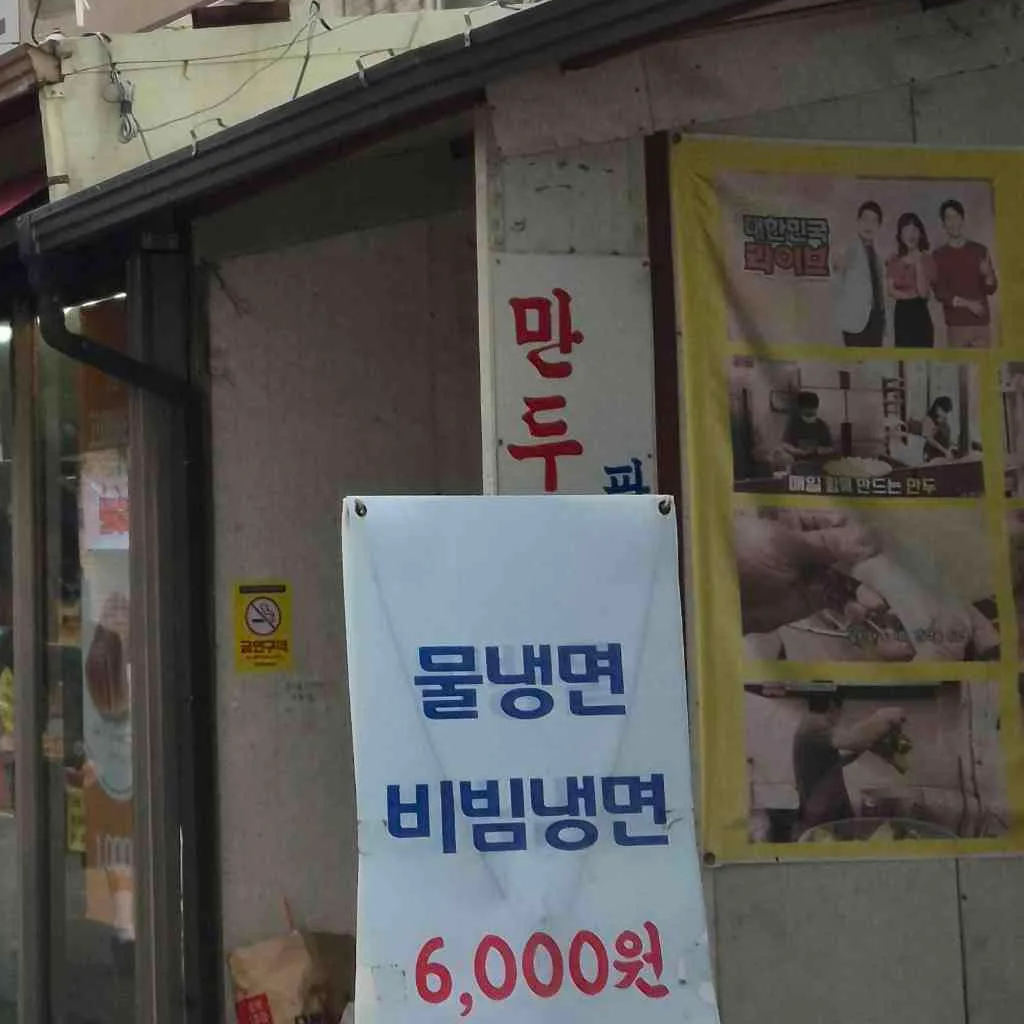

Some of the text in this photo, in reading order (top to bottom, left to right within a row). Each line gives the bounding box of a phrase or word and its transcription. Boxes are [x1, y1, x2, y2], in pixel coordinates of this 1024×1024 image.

[743, 214, 829, 245] 대한민국
[507, 288, 584, 493] 만두
[414, 642, 626, 720] 물냉면
[386, 772, 669, 854] 비빔냉면
[414, 919, 669, 1017] 6,000원
